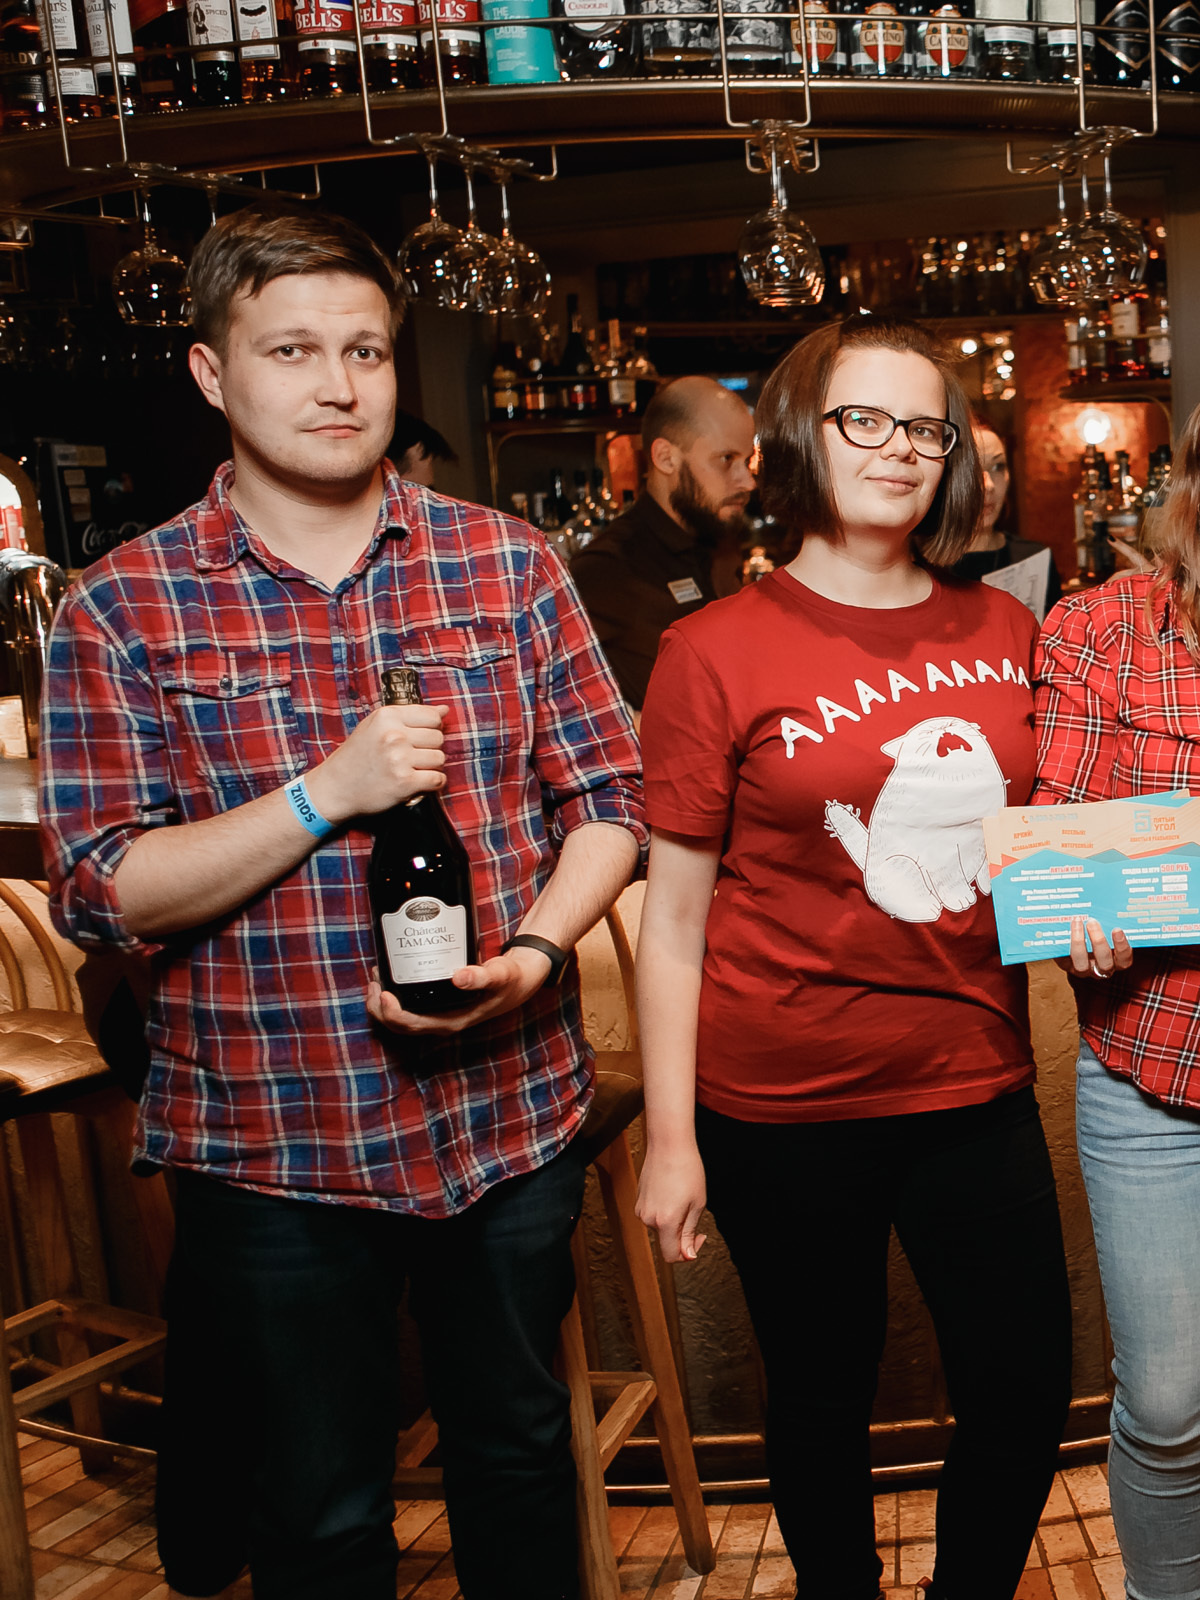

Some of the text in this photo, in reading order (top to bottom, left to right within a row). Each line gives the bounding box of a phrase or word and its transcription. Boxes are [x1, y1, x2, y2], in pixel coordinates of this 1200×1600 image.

[295, 10, 342, 30] BELL'S
[92, 24, 102, 35] 18
[864, 28, 900, 43] CAINO
[929, 33, 966, 48] CAINO
[1154, 823, 1176, 831] УГОЛ
[396, 933, 457, 948] TAMAGNE
